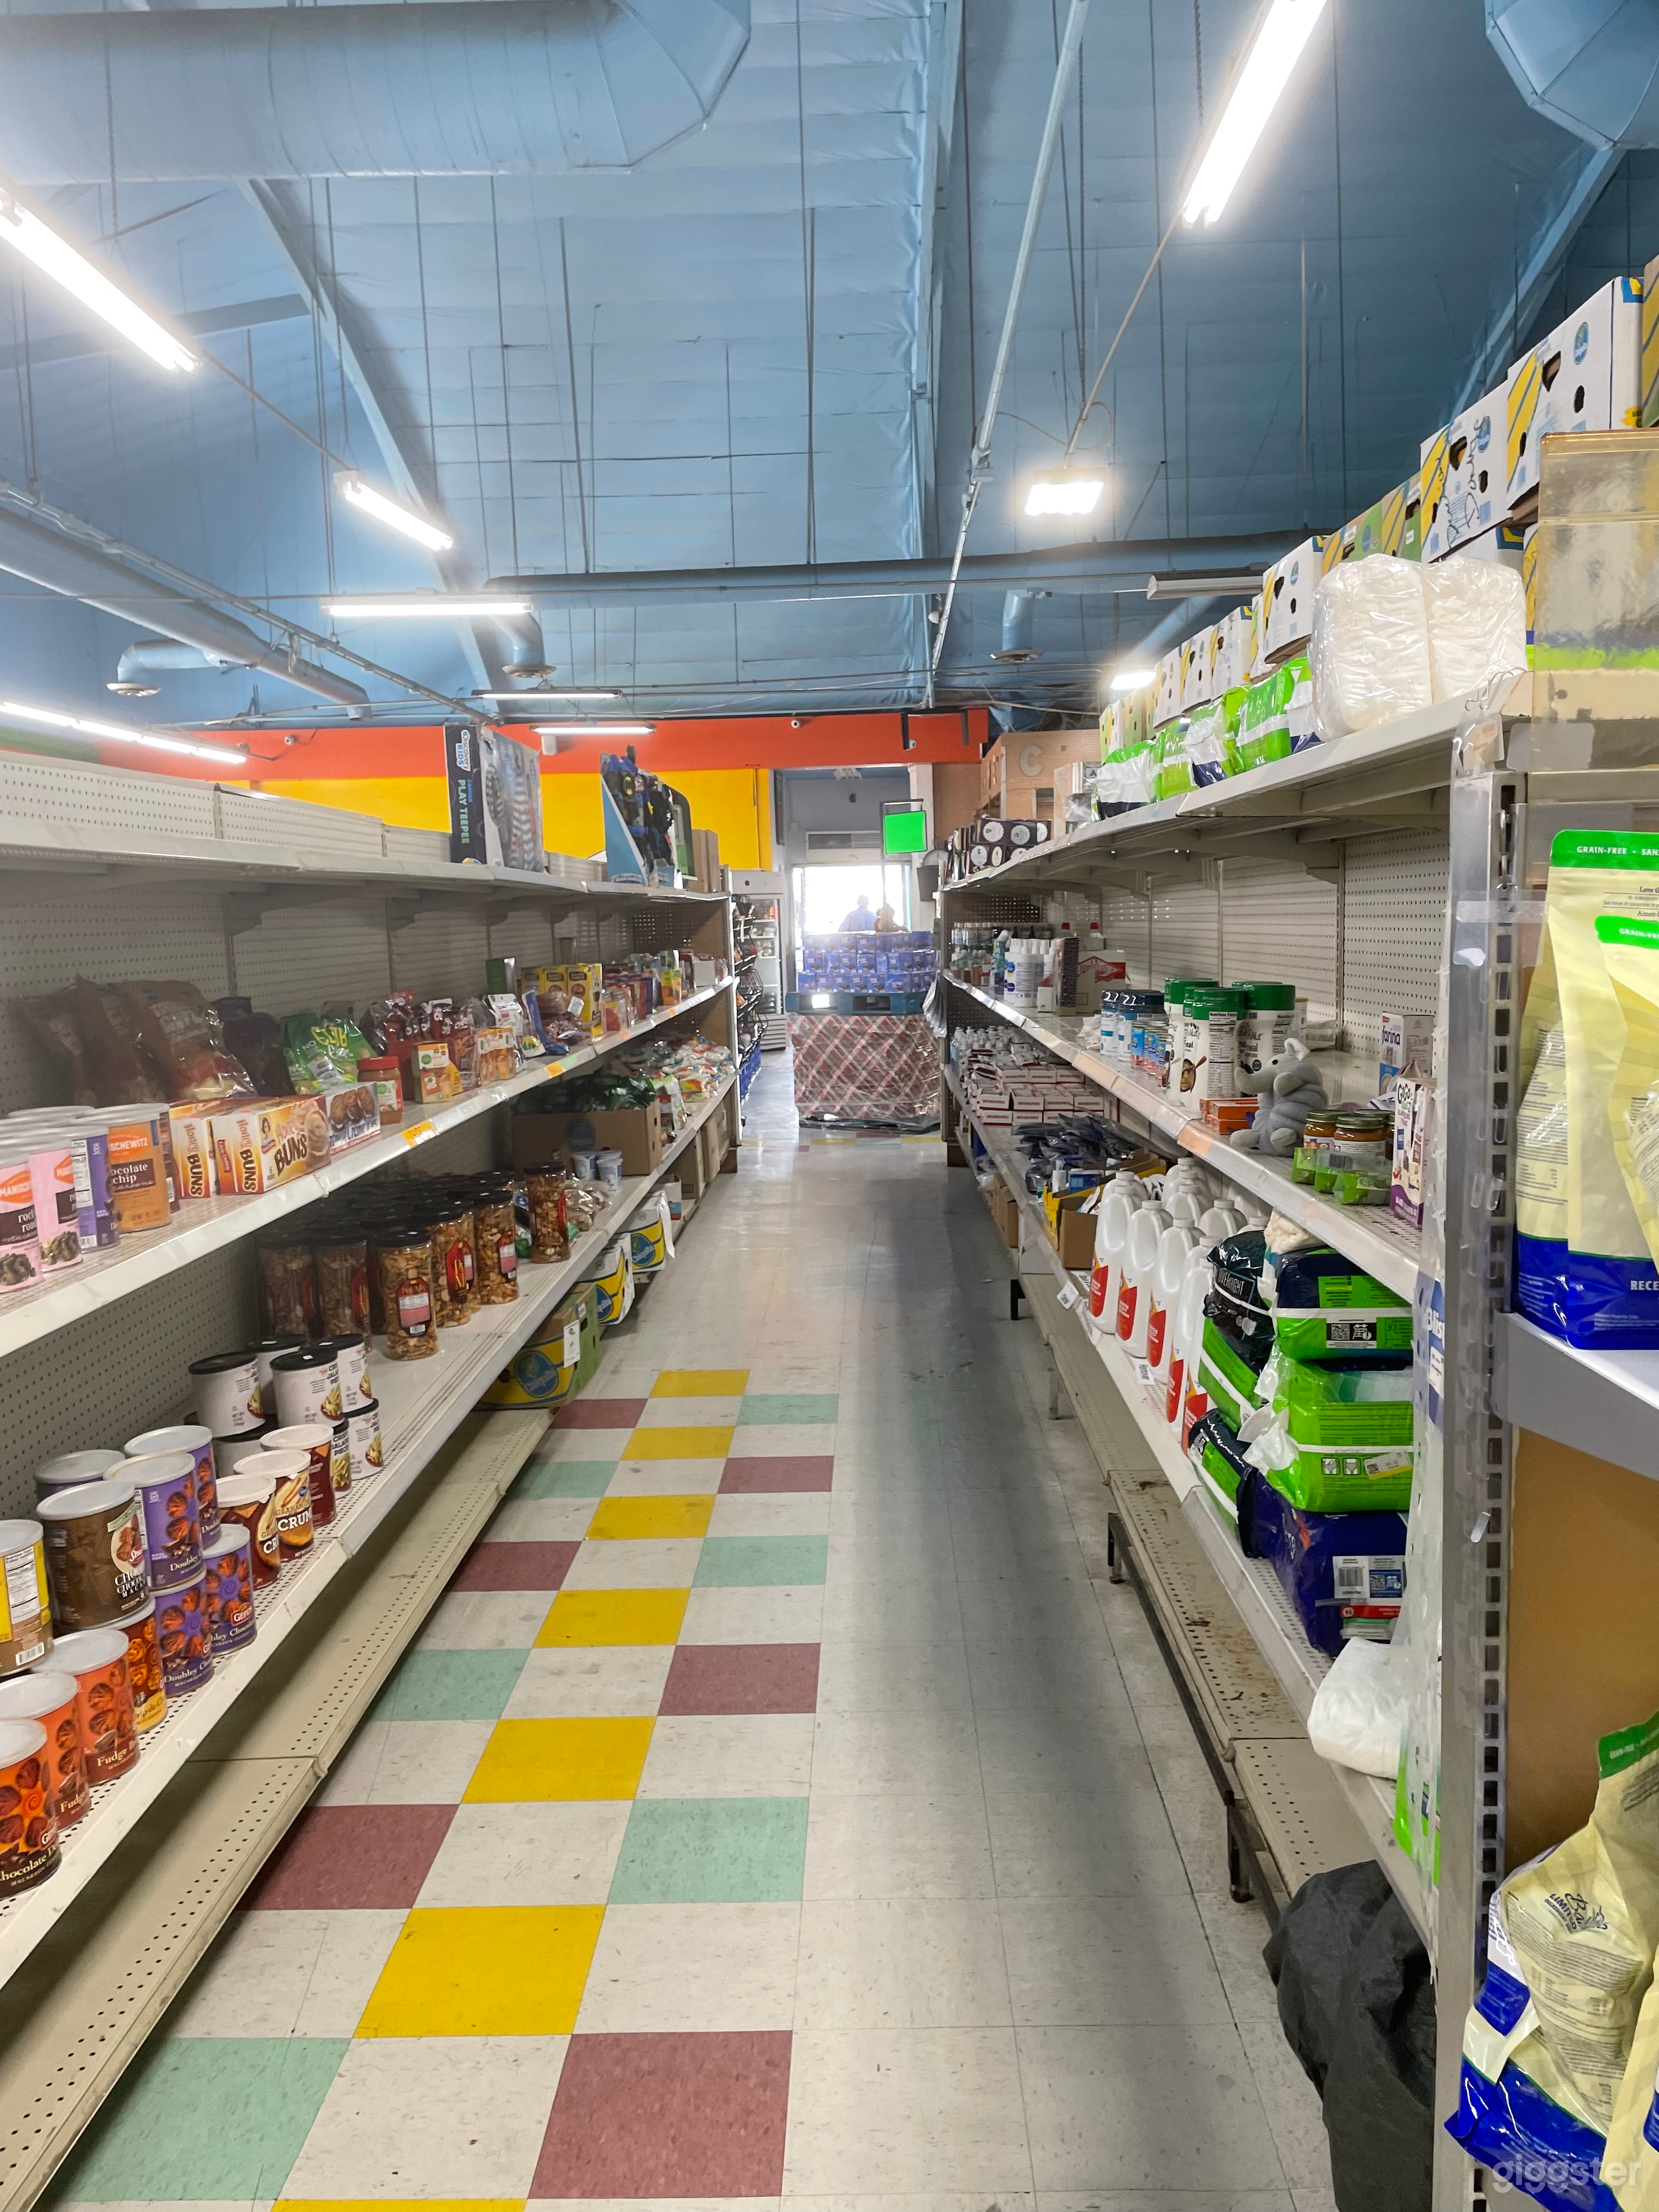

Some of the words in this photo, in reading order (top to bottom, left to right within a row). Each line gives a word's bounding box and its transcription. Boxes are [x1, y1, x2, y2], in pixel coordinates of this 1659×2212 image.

[458, 779, 468, 806] PLAY
[460, 808, 470, 844] TEEPEE
[1577, 846, 1627, 855] GRAIN-FREE
[274, 1133, 308, 1177] BUNS
[113, 1174, 137, 1184] chip
[186, 1153, 203, 1196] BUNS
[239, 1149, 257, 1192] BUNS
[631, 1244, 655, 1264] Chiquita
[524, 1367, 558, 1391] Chiquita
[164, 1668, 198, 1683] Doubley
[96, 1748, 127, 1767] Fudge
